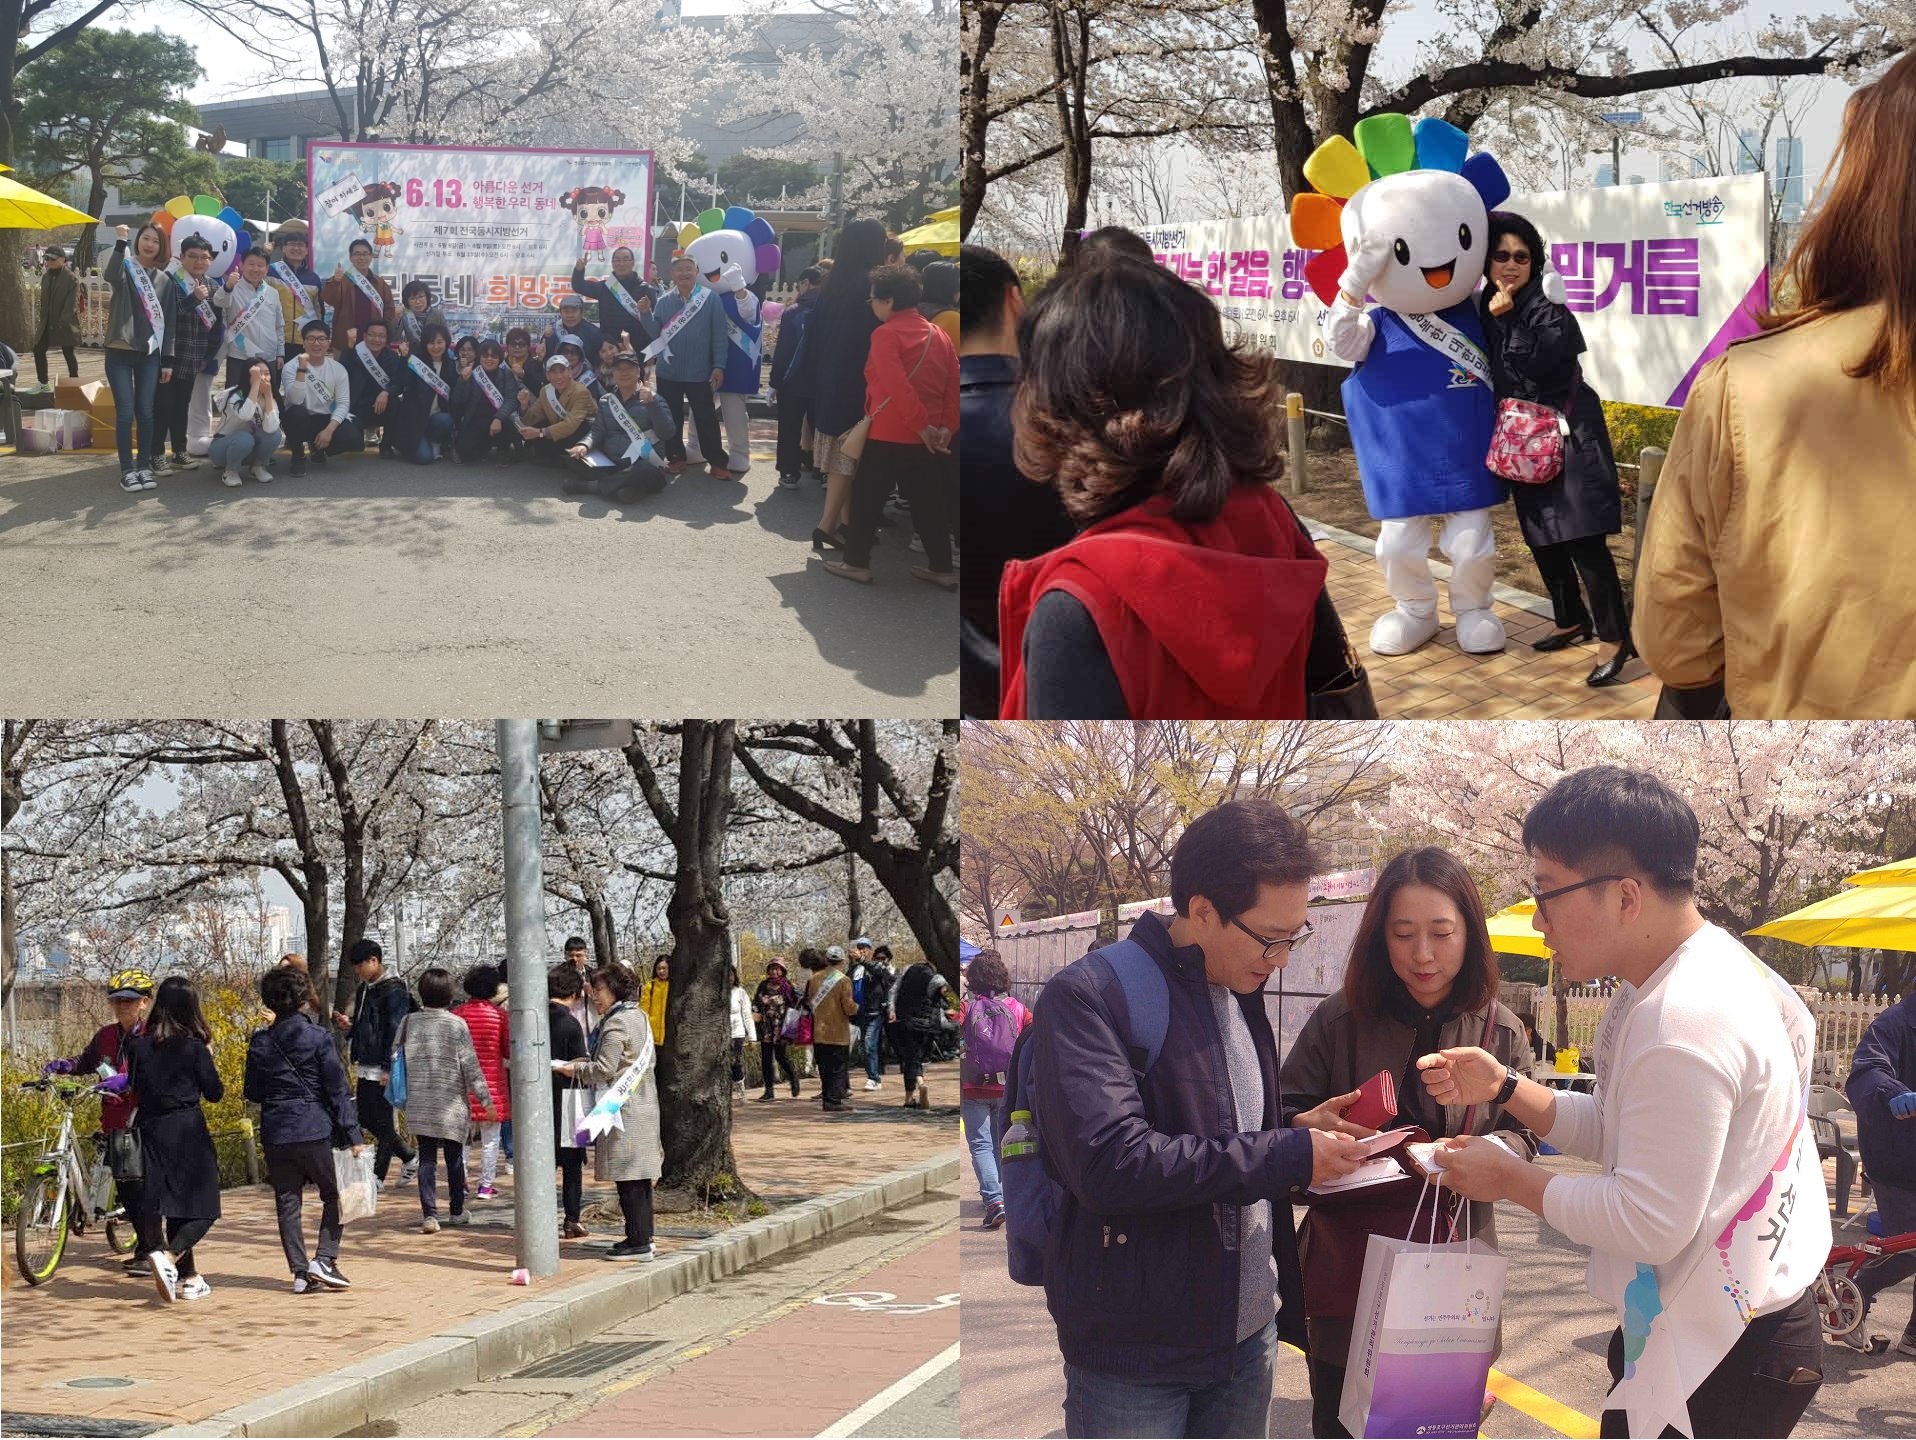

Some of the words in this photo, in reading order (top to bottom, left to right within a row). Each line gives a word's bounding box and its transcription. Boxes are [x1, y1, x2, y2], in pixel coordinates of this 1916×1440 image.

[406, 178, 467, 208] 6.13.
[473, 180, 518, 194] 아름다운
[521, 181, 544, 194] 선거
[473, 196, 507, 210] 행복한
[509, 197, 531, 210] 우리
[534, 197, 556, 211] 동네
[1664, 195, 1723, 217] 한국선거방송
[433, 225, 458, 236] 제7회
[460, 226, 529, 238] 전국동시지방선거
[1756, 1182, 1797, 1262] 선거
